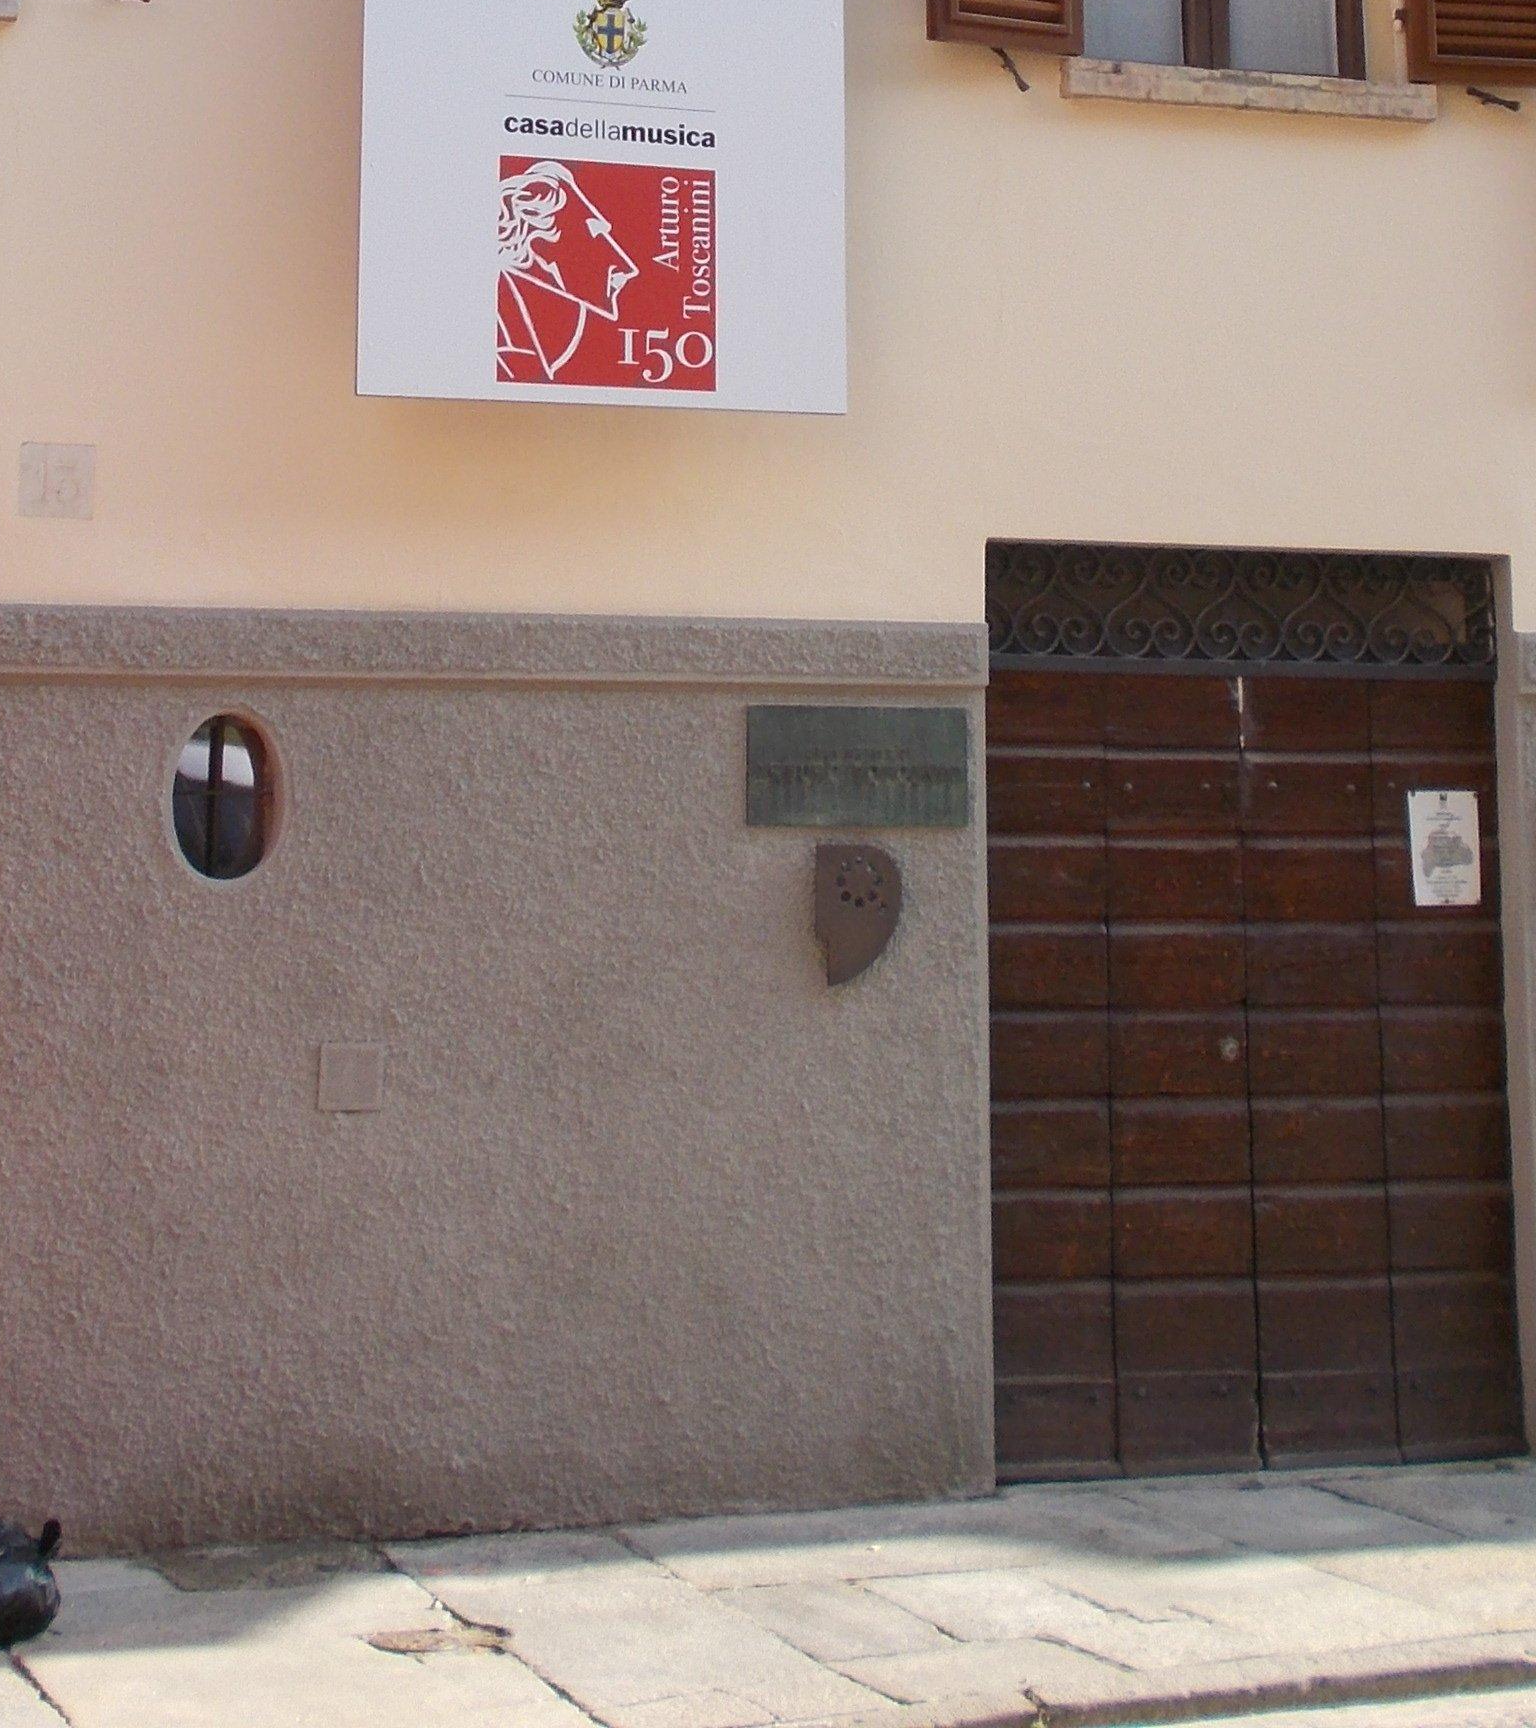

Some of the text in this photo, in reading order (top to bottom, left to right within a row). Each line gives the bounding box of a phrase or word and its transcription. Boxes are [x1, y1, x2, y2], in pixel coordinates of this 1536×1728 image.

[531, 69, 689, 95] COMUNE DI PARMA
[504, 113, 716, 148] casadellamusica
[652, 176, 680, 273] Arturo
[683, 179, 711, 320] Toscanini
[617, 327, 713, 383] 150
